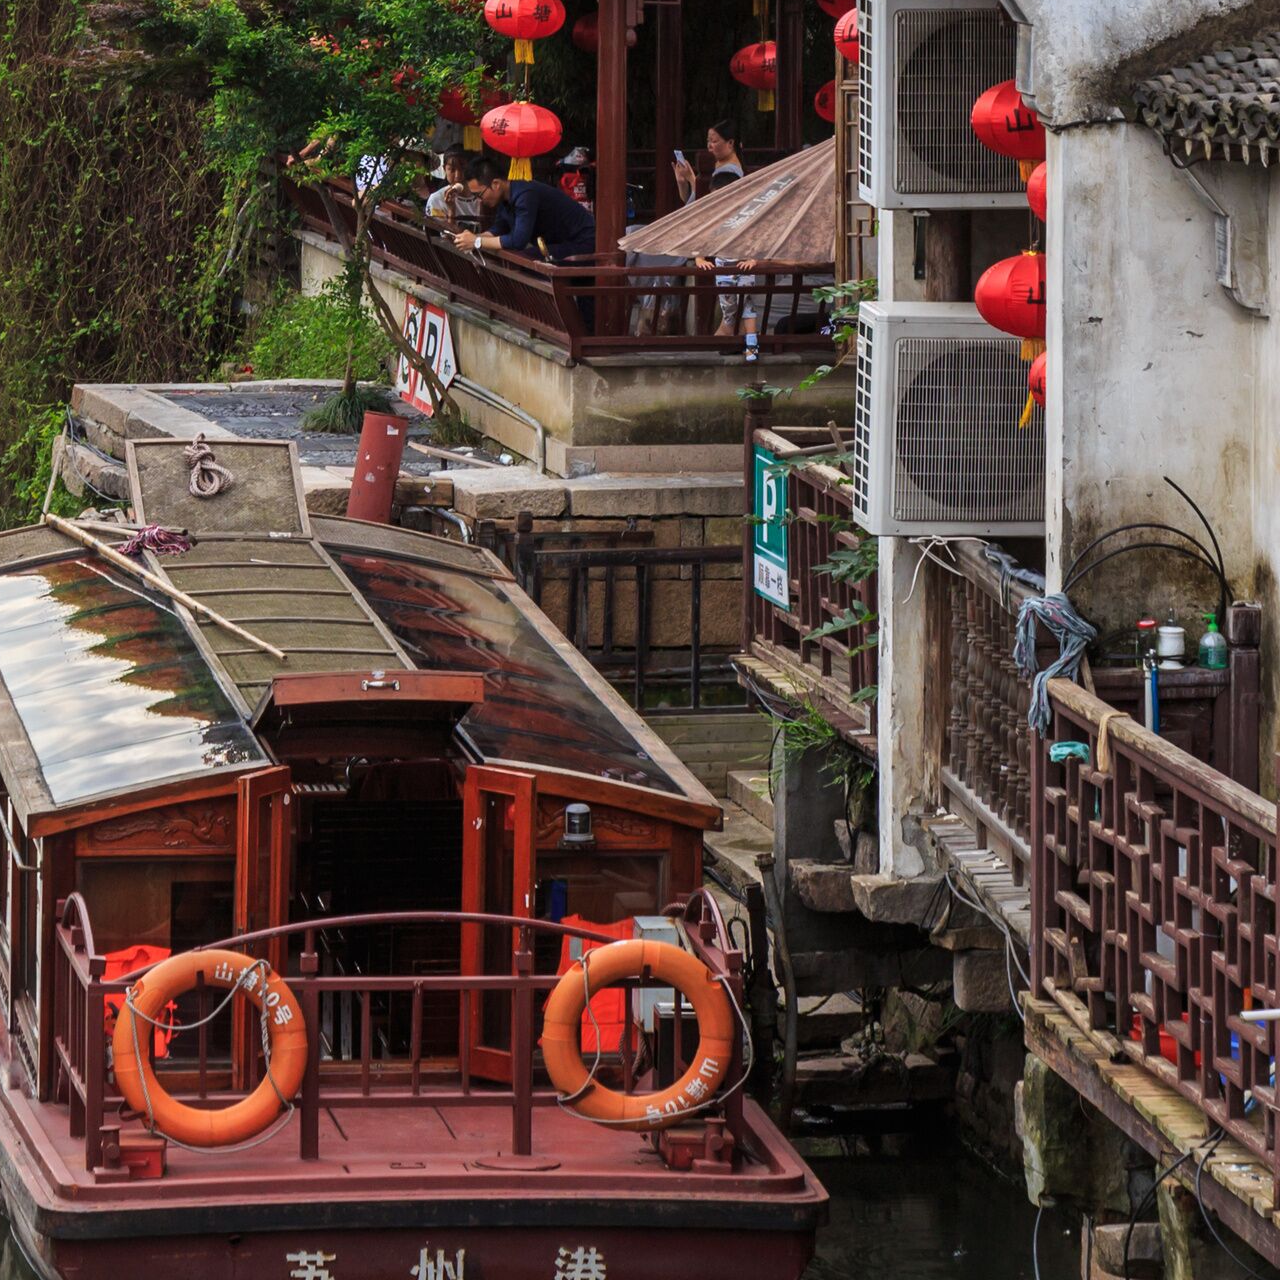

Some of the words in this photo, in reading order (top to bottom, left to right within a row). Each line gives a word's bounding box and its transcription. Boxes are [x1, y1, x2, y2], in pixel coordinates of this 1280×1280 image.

[496, 3, 513, 20] 山
[491, 118, 509, 136] 塘
[1006, 108, 1034, 133] 山
[420, 321, 438, 392] P
[762, 468, 777, 544] P
